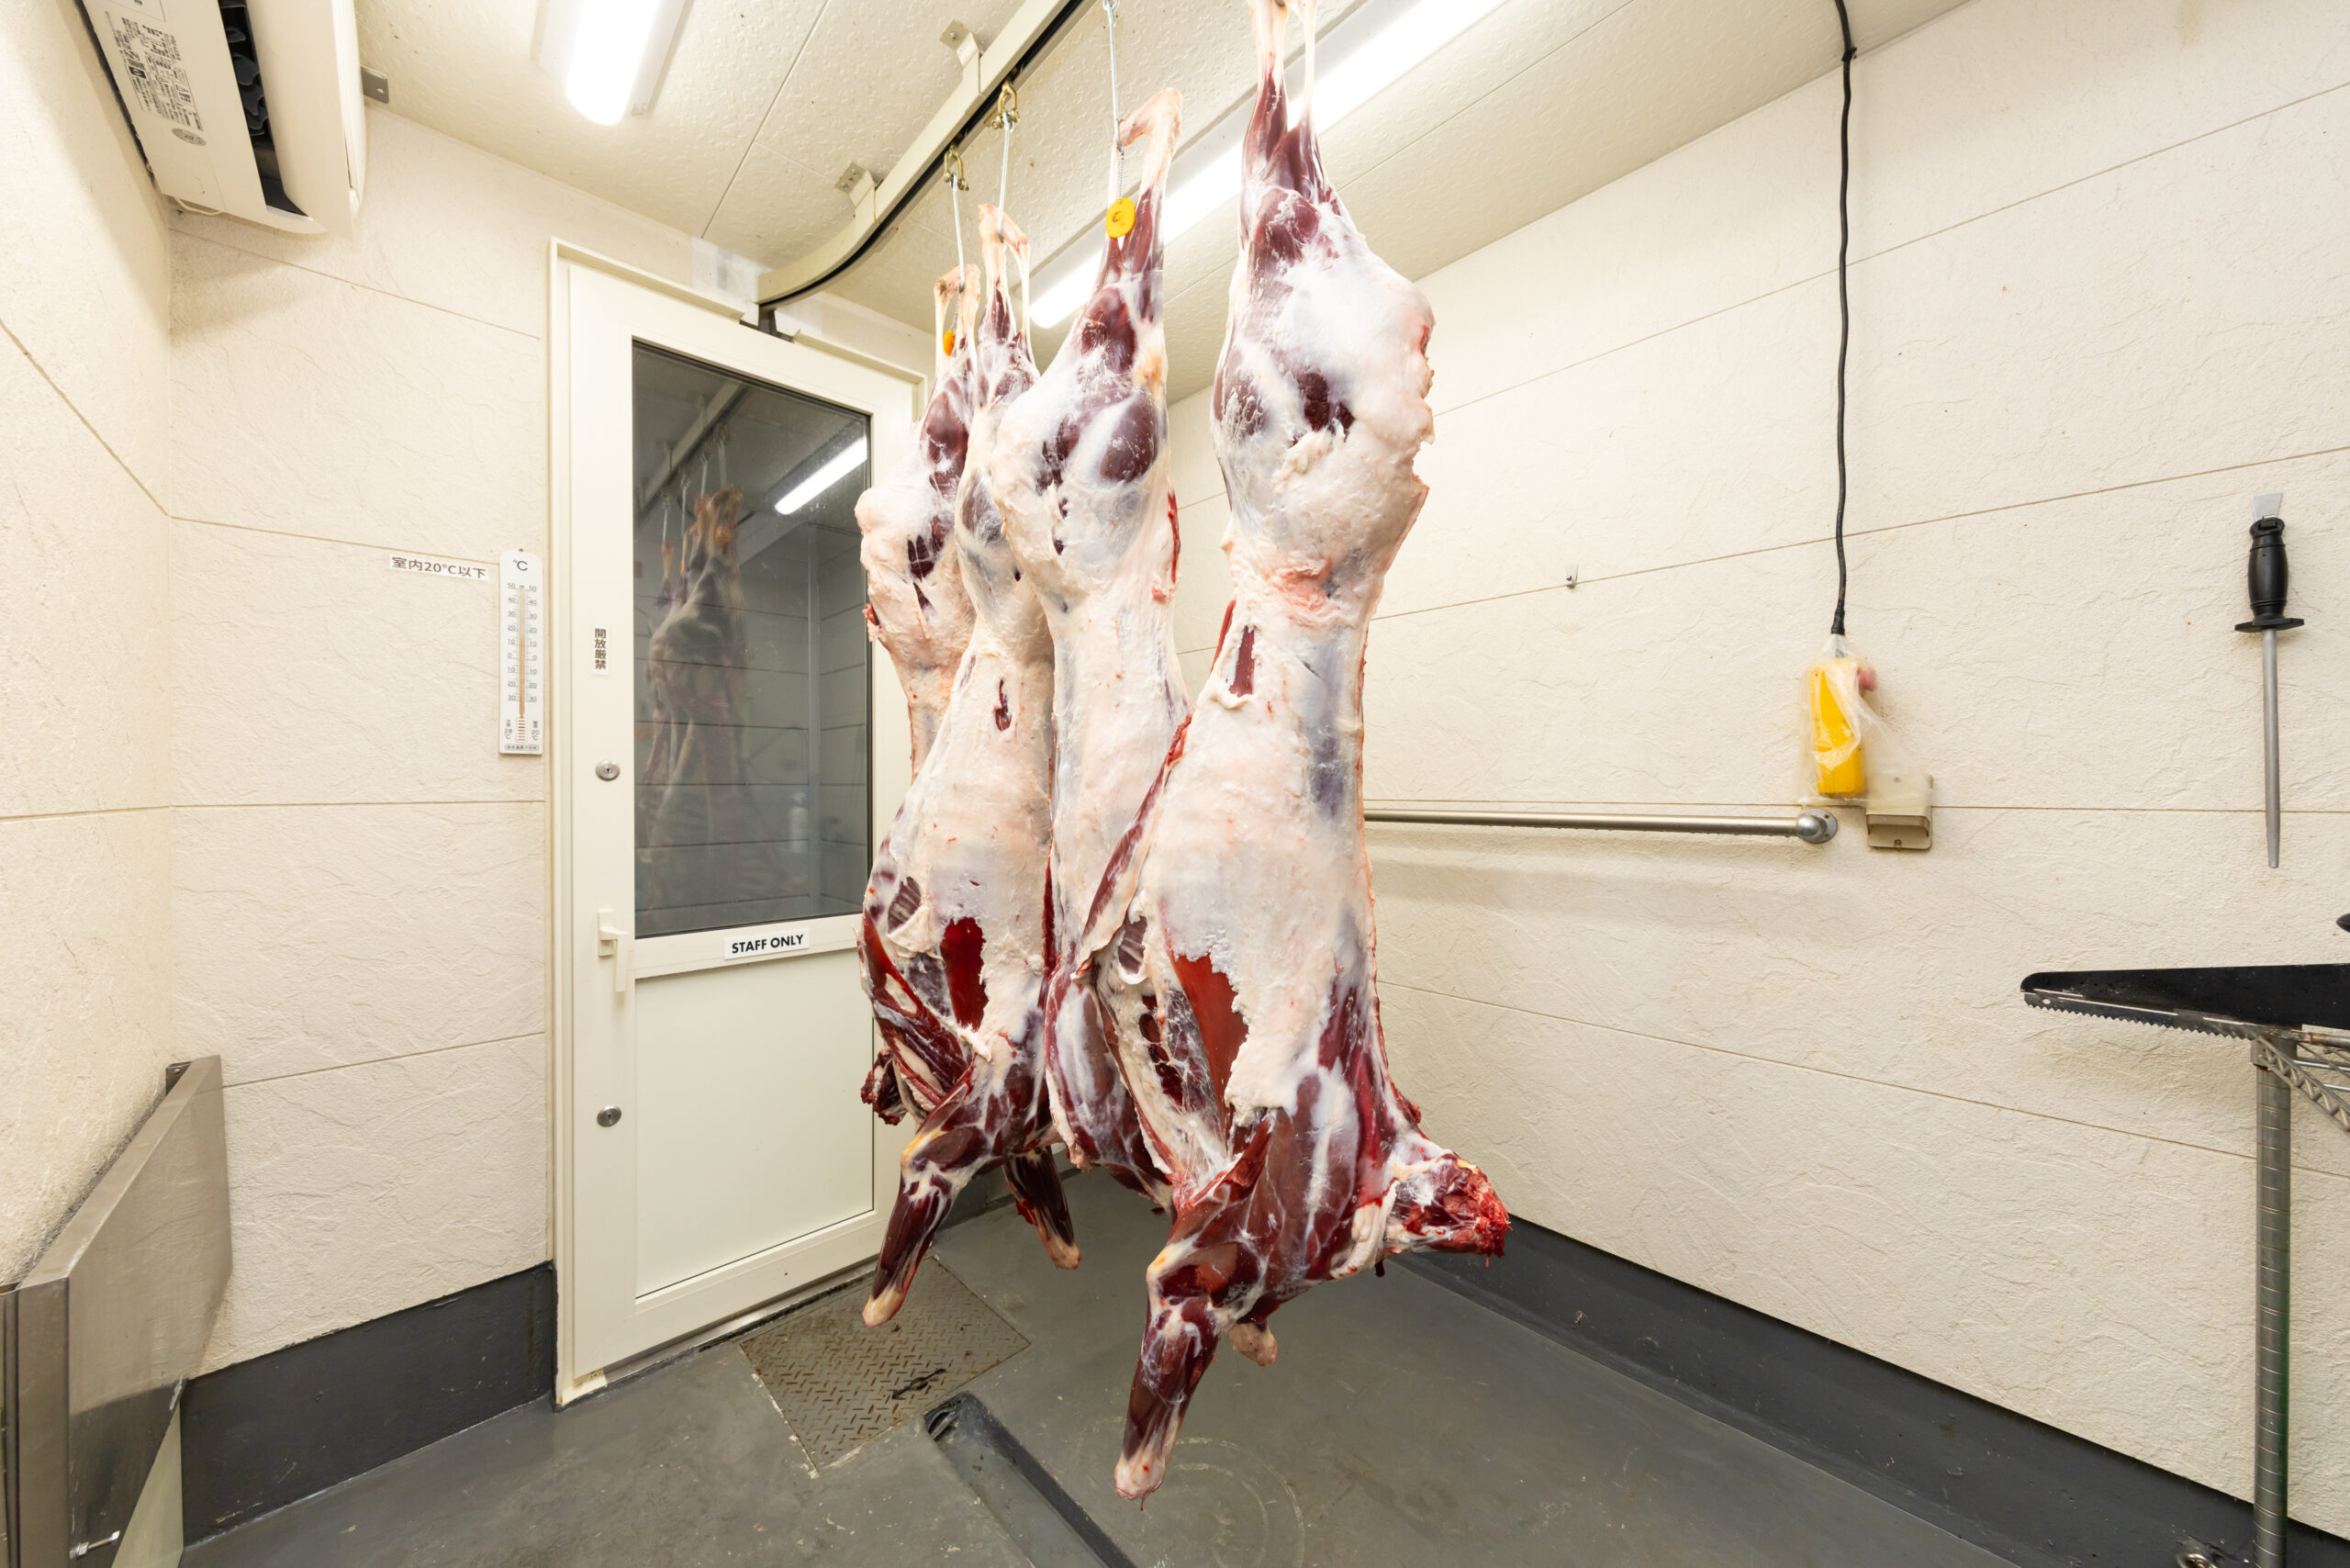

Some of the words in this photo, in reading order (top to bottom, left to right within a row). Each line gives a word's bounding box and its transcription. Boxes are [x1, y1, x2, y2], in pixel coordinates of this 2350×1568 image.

[392, 556, 487, 578] 室内20°C以下
[512, 559, 528, 571] °C
[595, 628, 607, 670] 開放厳禁
[732, 939, 767, 954] STAFF
[770, 934, 804, 948] ONLY
